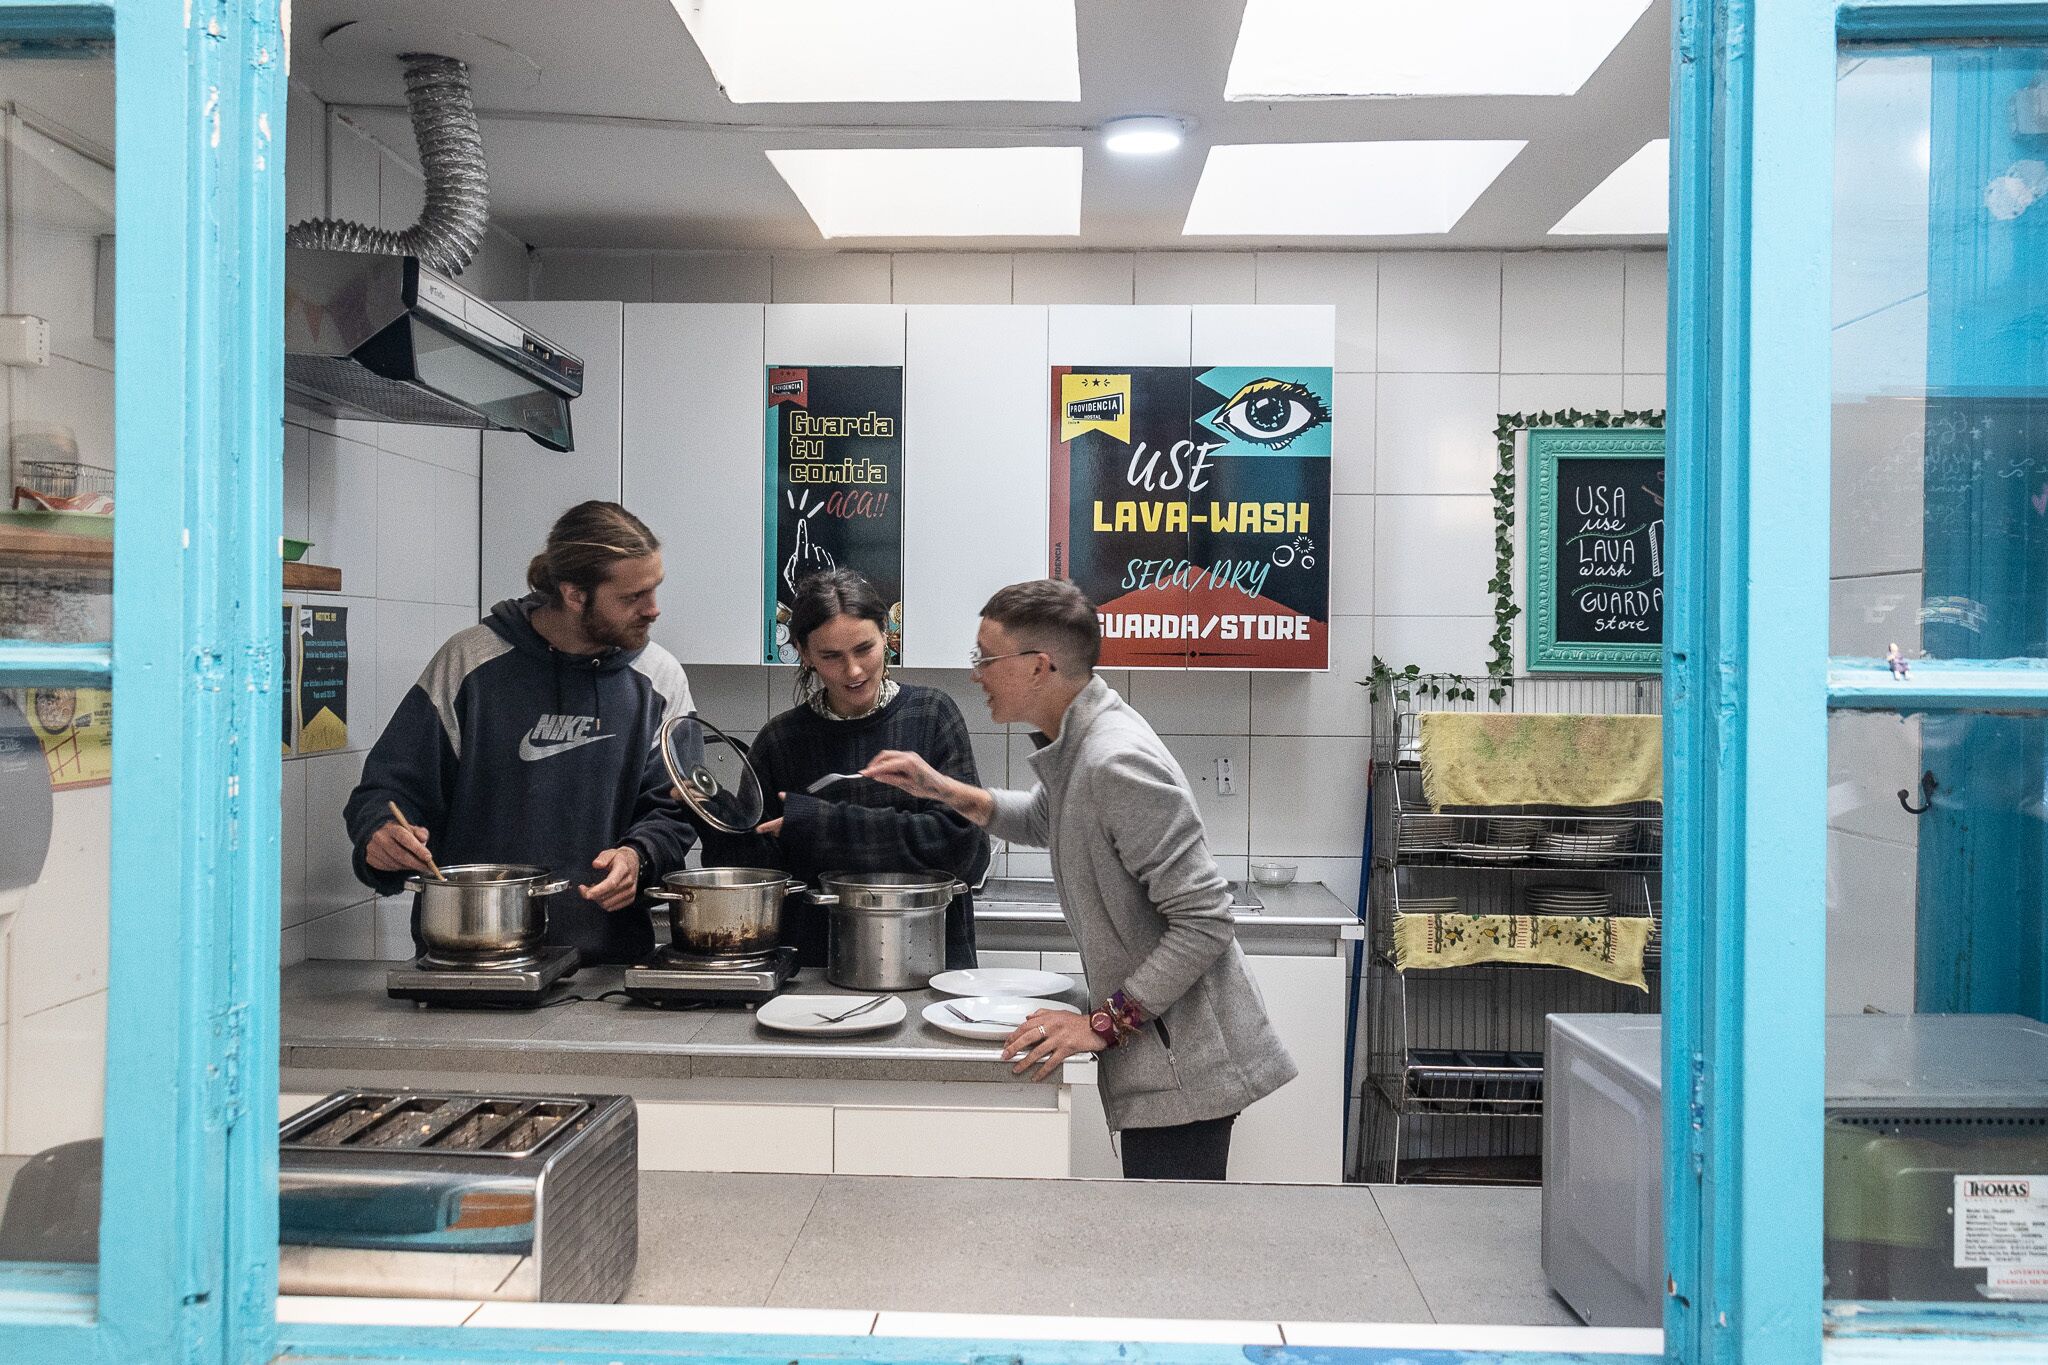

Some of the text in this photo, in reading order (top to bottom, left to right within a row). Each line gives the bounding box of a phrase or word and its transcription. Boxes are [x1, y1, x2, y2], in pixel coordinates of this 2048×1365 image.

[1069, 400, 1119, 413] PROVIDENCIA
[790, 410, 894, 438] Guarda
[790, 436, 824, 460] tu
[789, 458, 888, 484] comida
[1126, 439, 1229, 493] USE
[1575, 485, 1626, 518] USA
[1093, 500, 1310, 534] LAVA-WASH
[1579, 518, 1626, 533] use
[1579, 538, 1636, 565] LAVA
[1579, 562, 1633, 577] wash
[1580, 587, 1664, 617] GUARDA
[1594, 615, 1650, 632] store
[530, 713, 595, 741] NIKE
[1967, 1180, 2028, 1197] THOMAS
